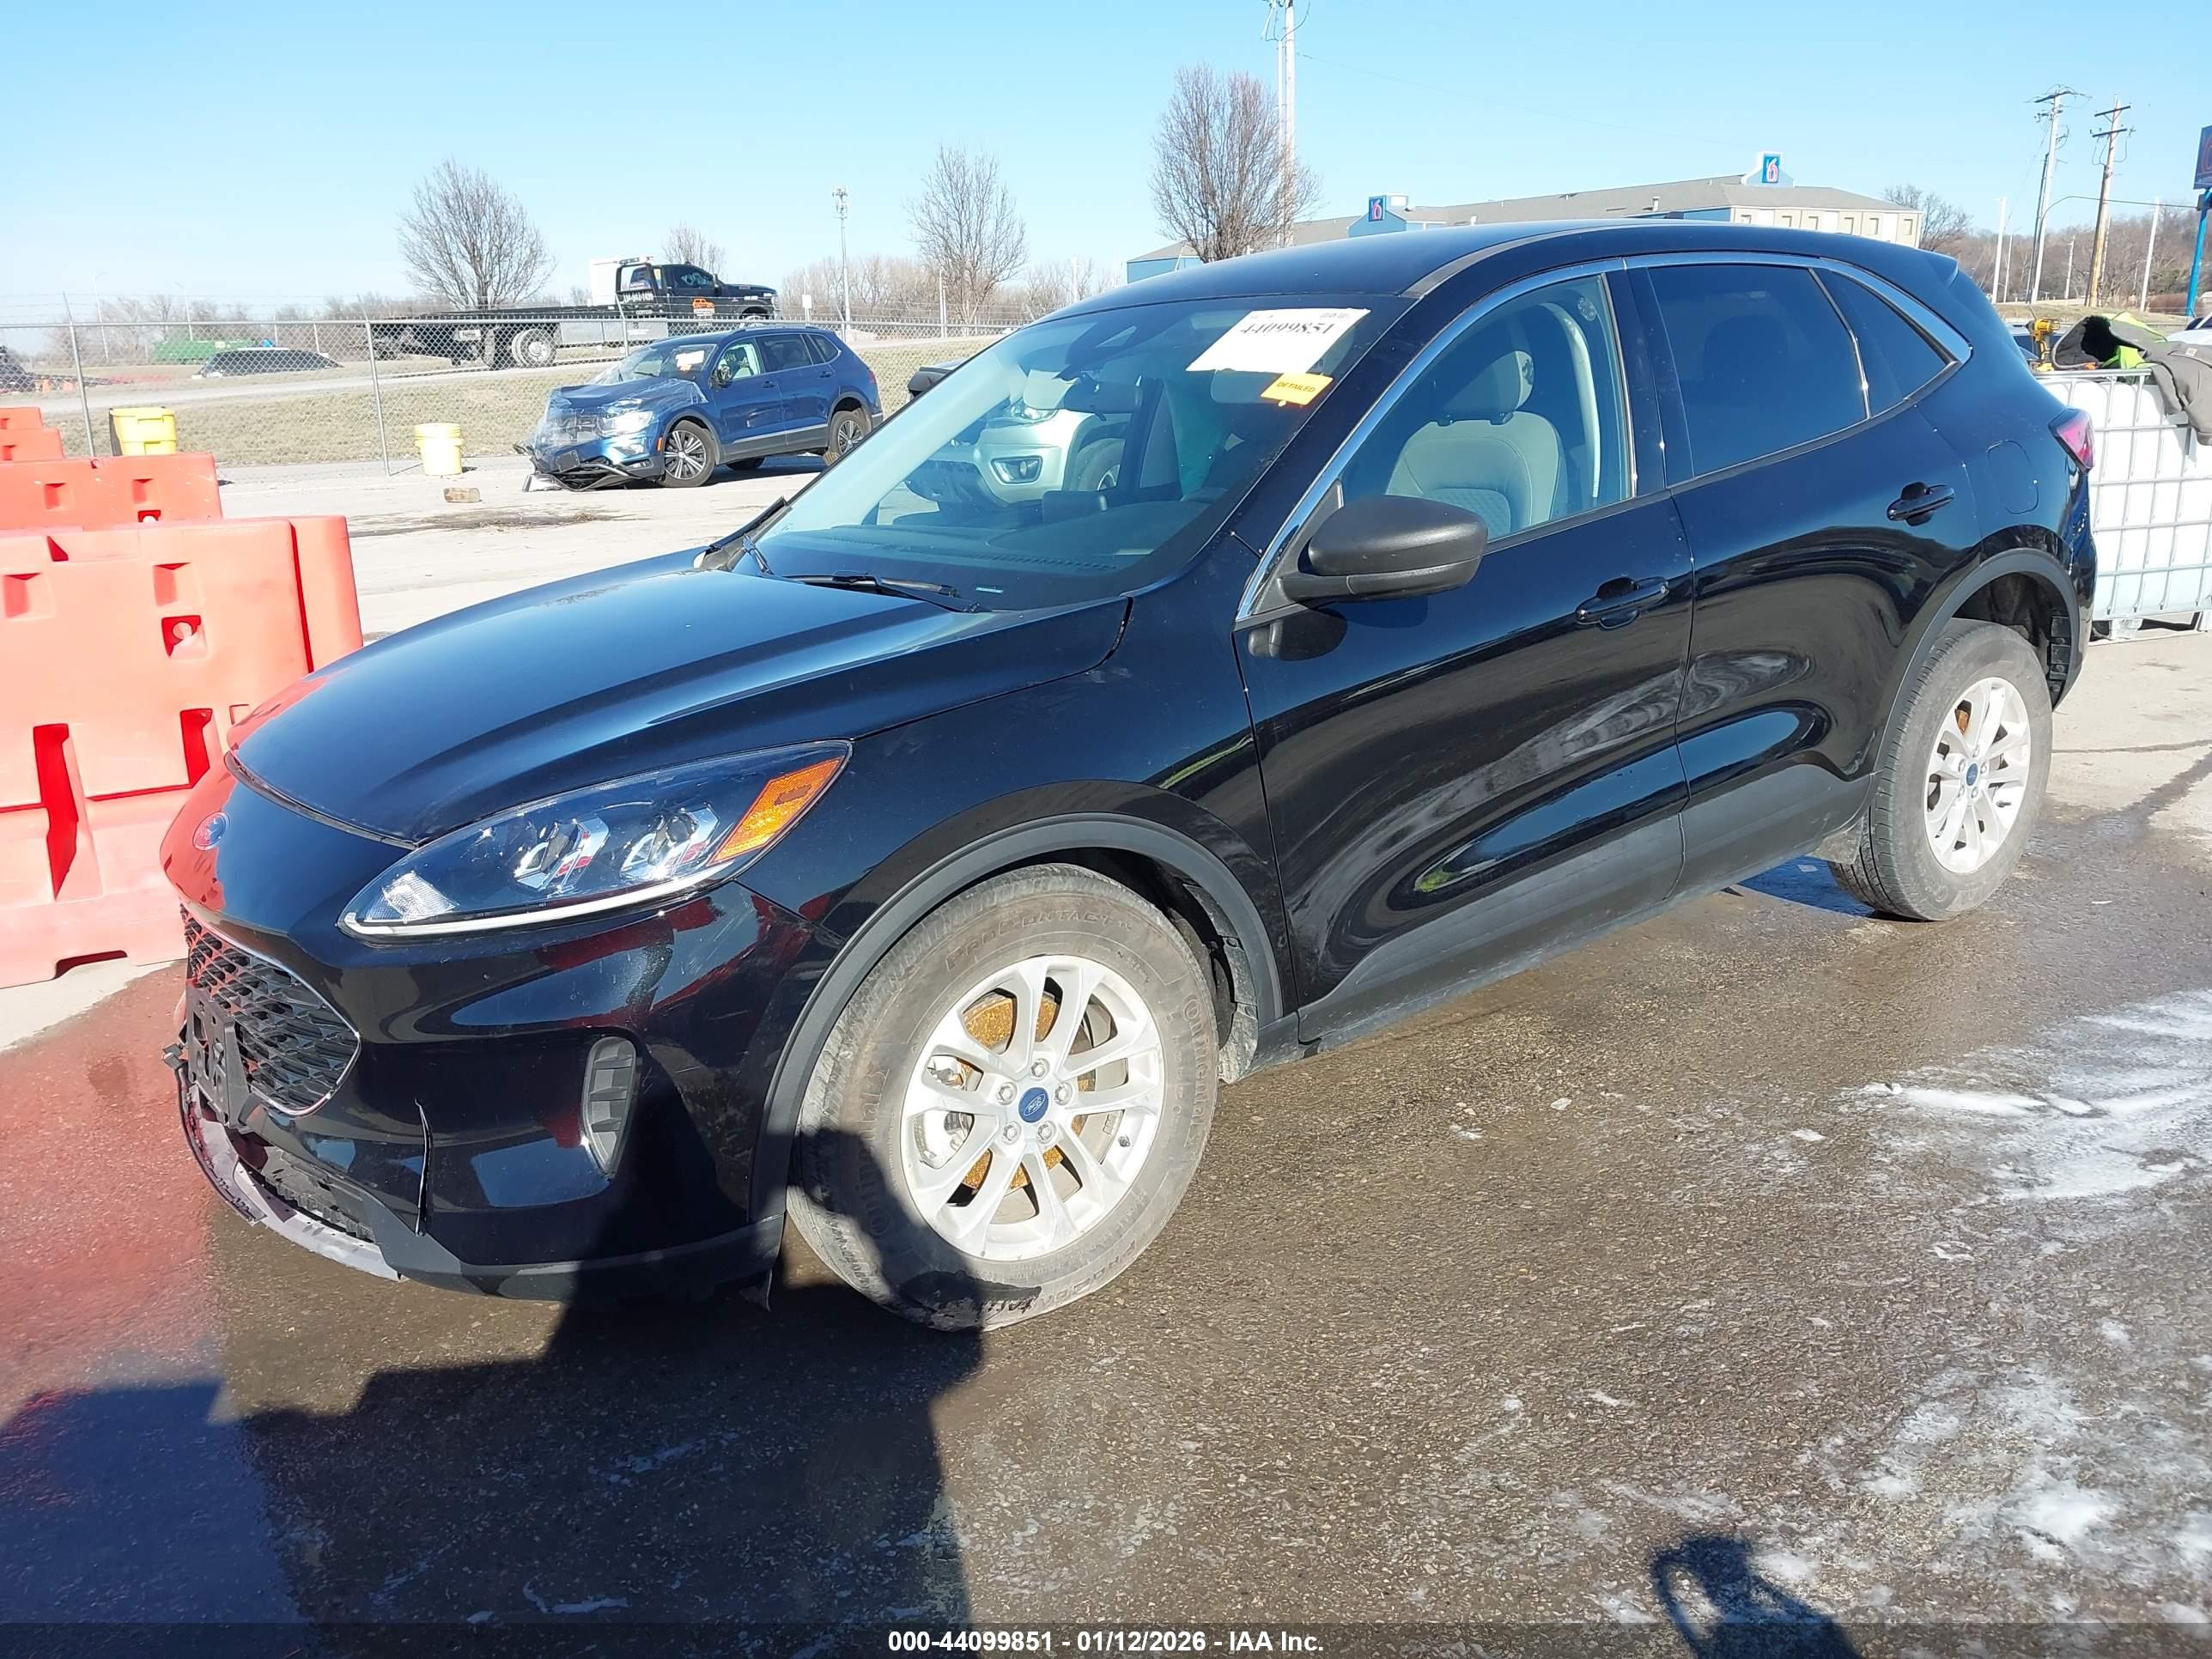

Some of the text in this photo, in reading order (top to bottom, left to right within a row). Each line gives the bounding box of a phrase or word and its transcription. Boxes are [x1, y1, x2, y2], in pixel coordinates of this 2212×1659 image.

[1766, 158, 1778, 182] 6
[1371, 198, 1382, 220] 6
[1240, 321, 1336, 336] 44099851
[1276, 380, 1316, 393] DETAILED
